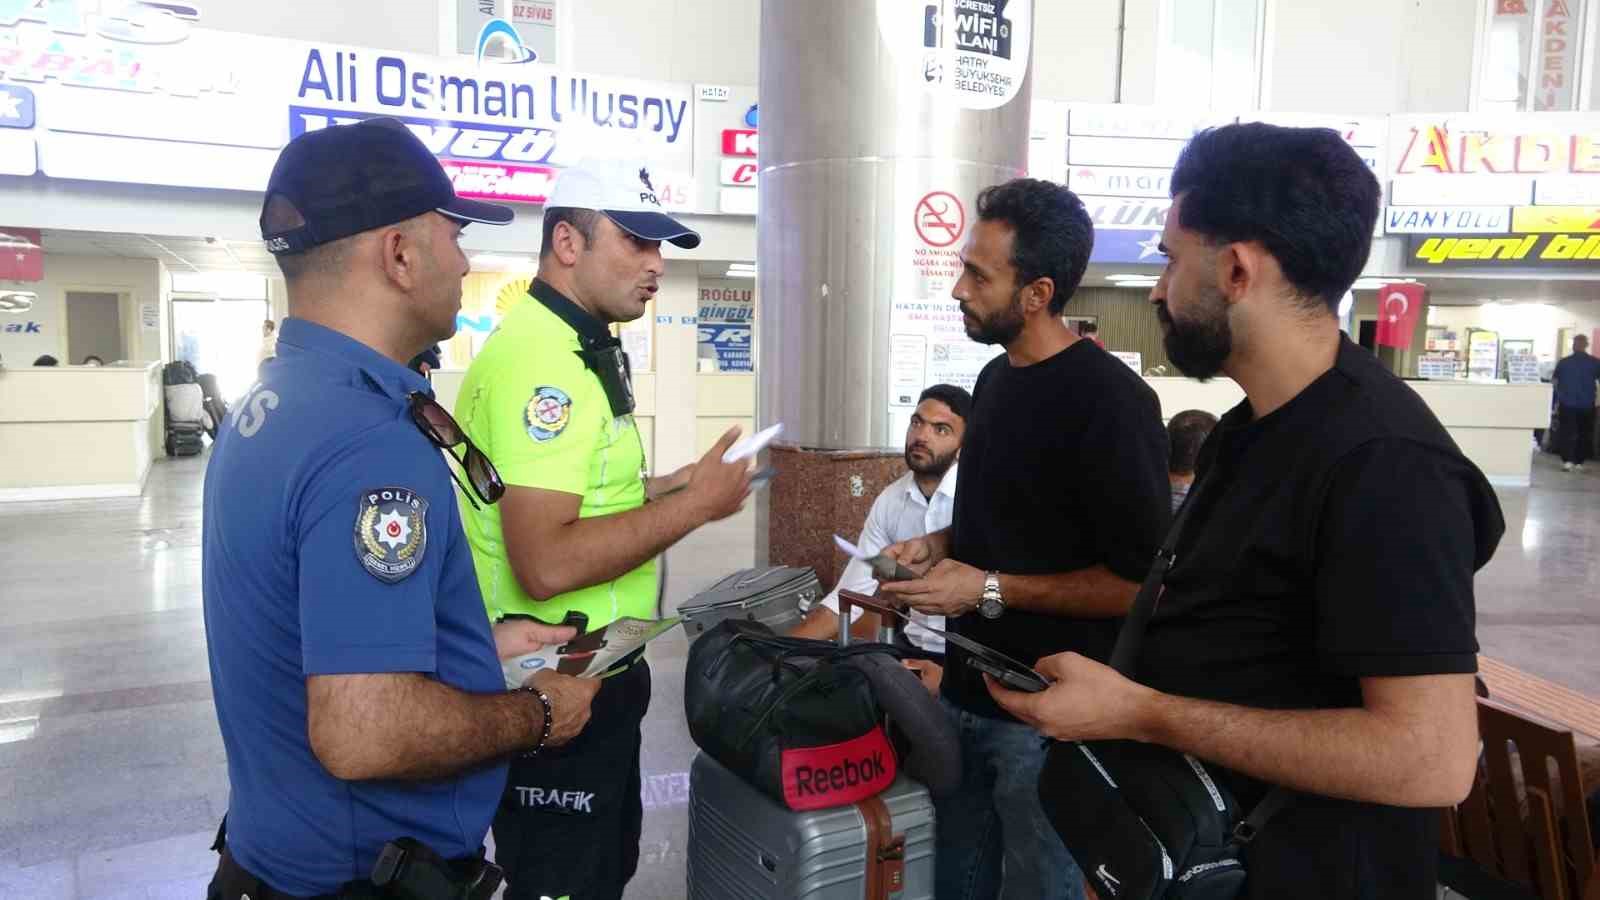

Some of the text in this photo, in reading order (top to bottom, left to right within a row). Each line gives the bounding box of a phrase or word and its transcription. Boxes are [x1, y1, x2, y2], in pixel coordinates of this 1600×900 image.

[298, 48, 358, 103] Ali
[376, 56, 535, 120] Osman
[550, 75, 688, 143] Ulusoy
[1416, 235, 1539, 263] yeni
[368, 491, 420, 509] POLİS
[795, 752, 886, 797] Reebok
